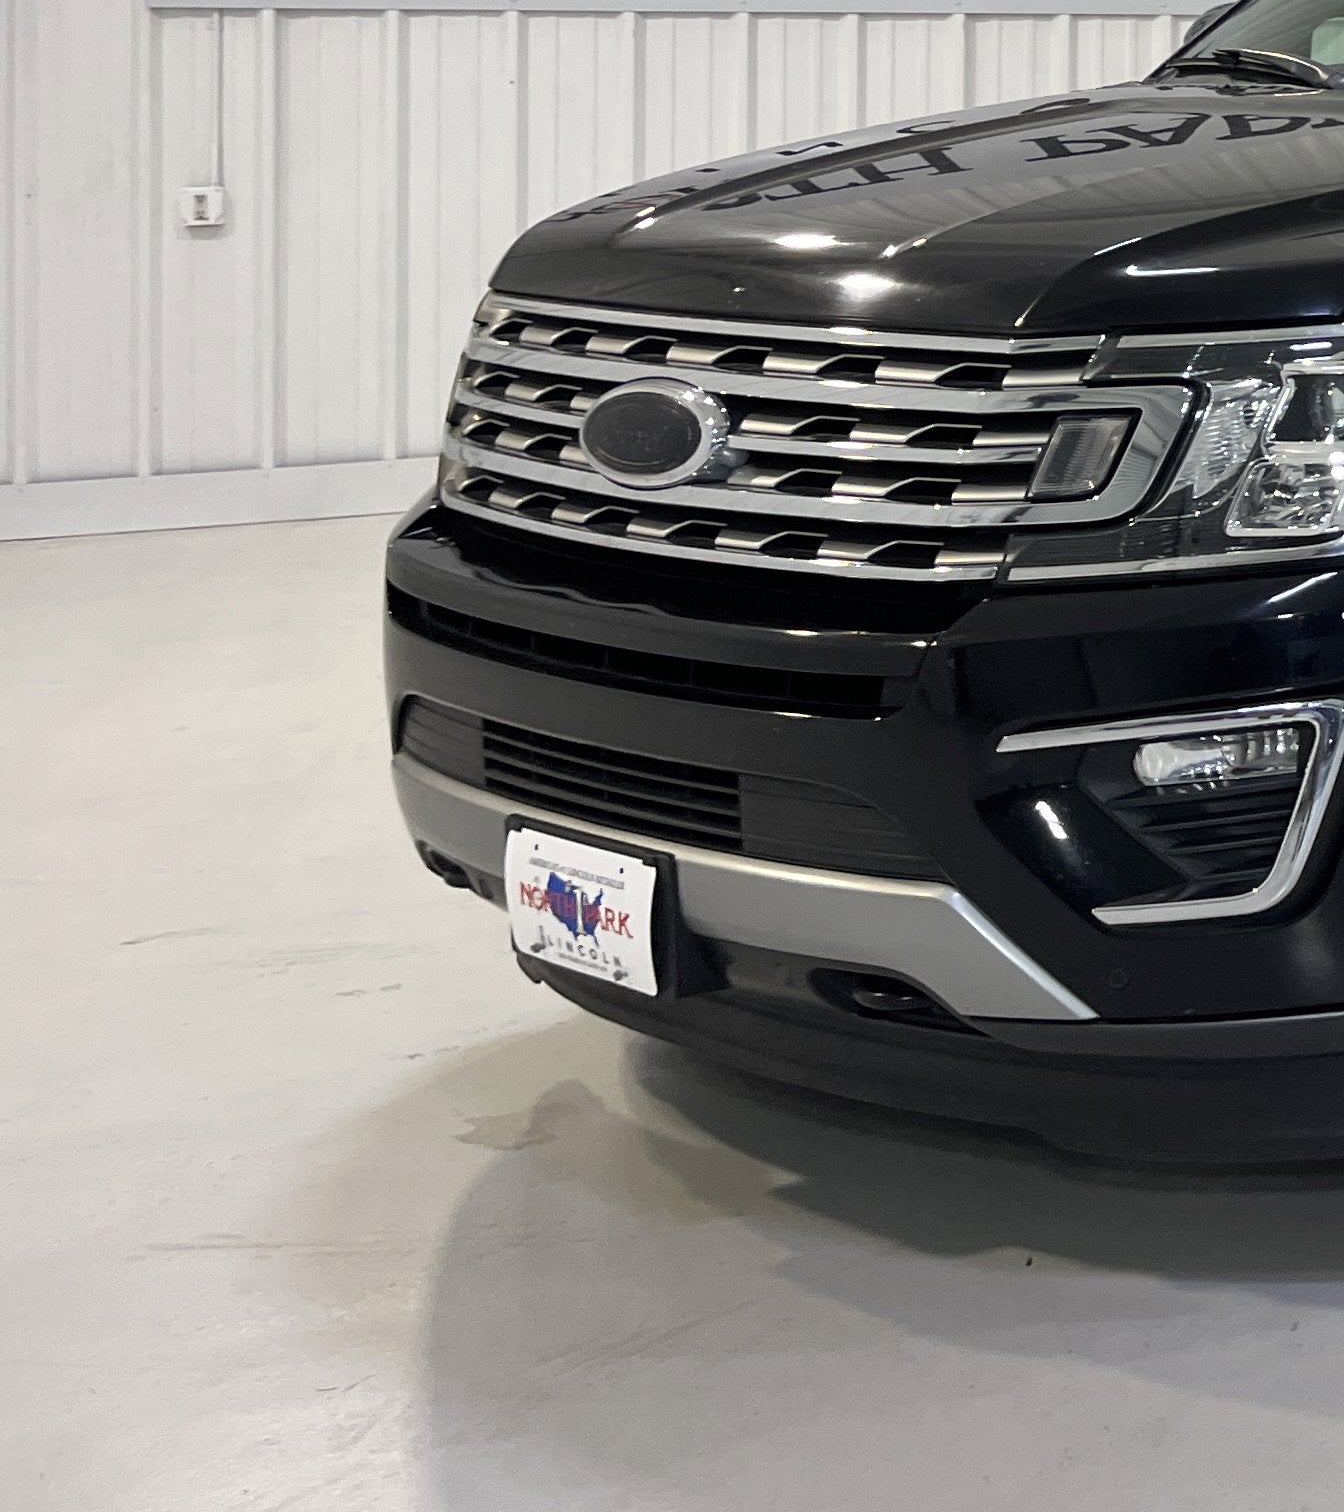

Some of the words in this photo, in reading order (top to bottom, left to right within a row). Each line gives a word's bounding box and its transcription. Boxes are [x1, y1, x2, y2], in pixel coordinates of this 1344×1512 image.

[519, 881, 577, 919] NORTH
[582, 903, 634, 939] PARK
[547, 934, 622, 968] LINCOLN
